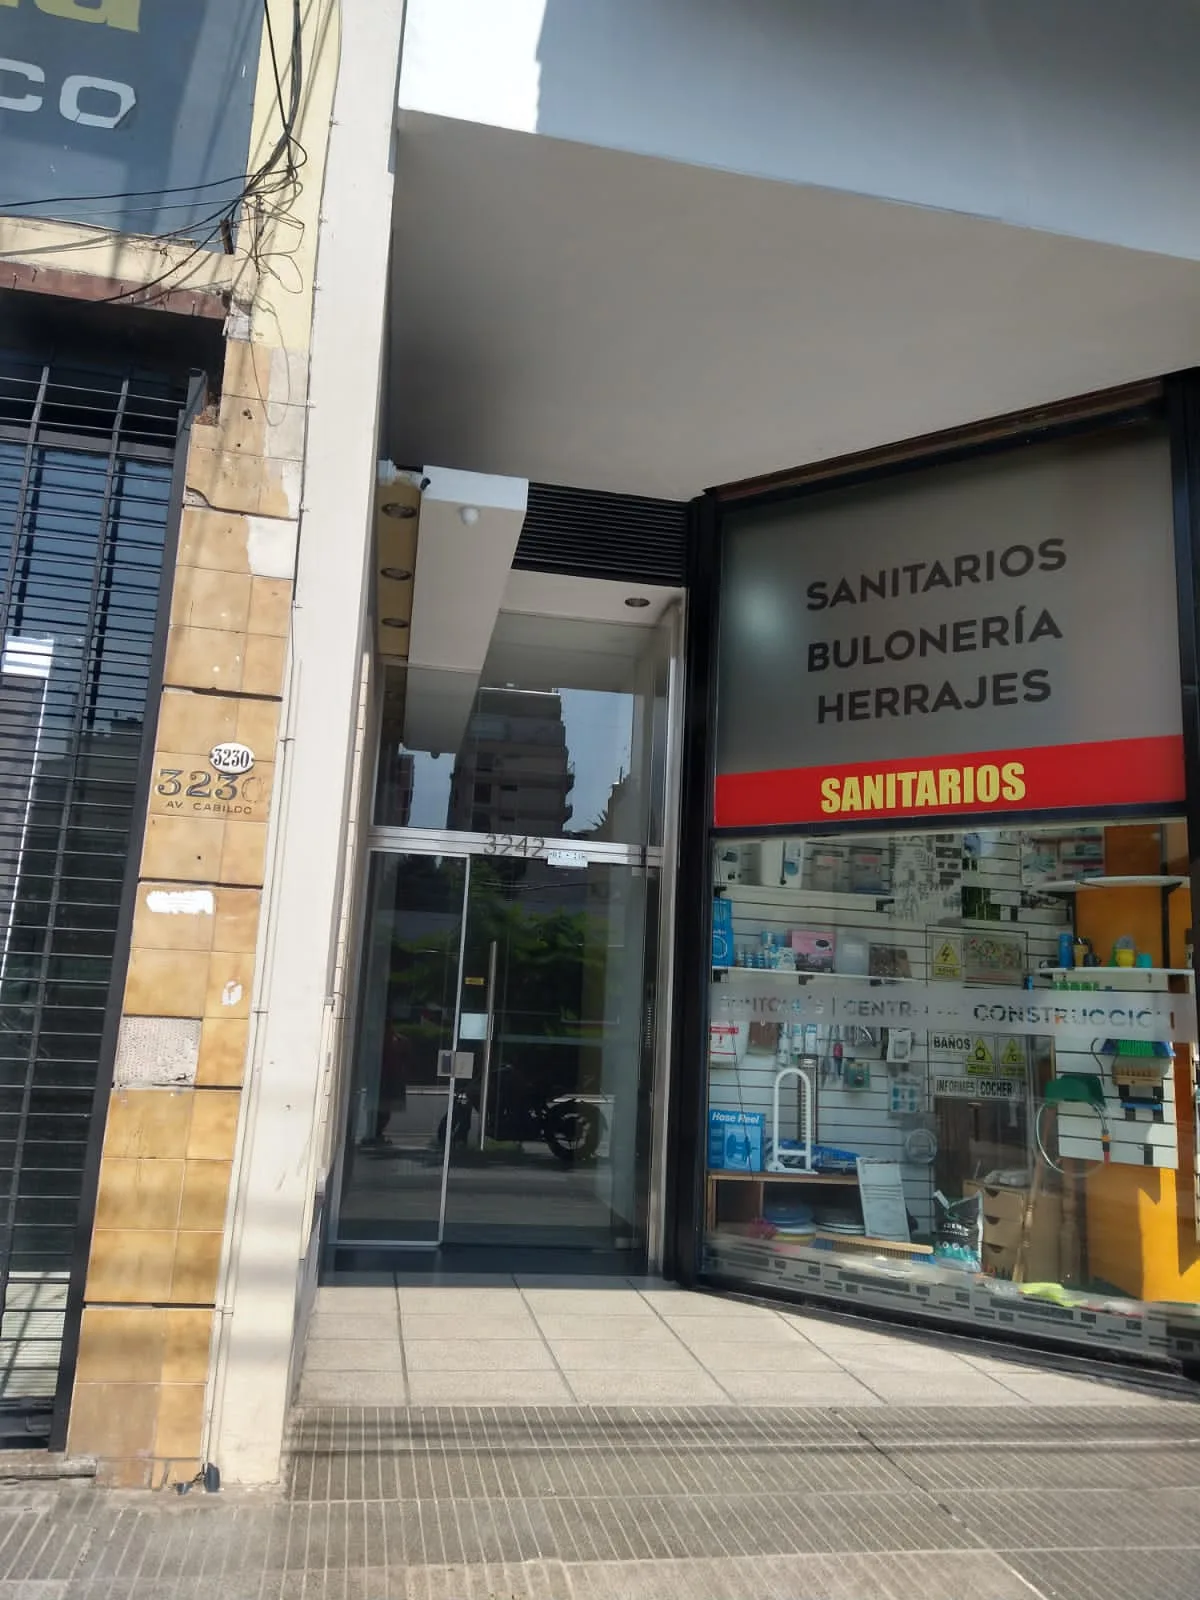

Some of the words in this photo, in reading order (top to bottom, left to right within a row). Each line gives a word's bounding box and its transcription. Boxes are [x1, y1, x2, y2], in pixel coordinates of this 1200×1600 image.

[806, 538, 1067, 611] SANITARIOS
[807, 605, 1063, 673] BULONERÍA
[817, 668, 1052, 724] HERRAJES
[213, 748, 250, 769] 3230
[820, 761, 1026, 814] SANITARIOS
[193, 802, 252, 815] CABILDO
[483, 832, 545, 858] 3242
[934, 1035, 971, 1051] BAÑOS
[711, 1111, 737, 1122] Hose
[738, 1113, 760, 1125] Reel
